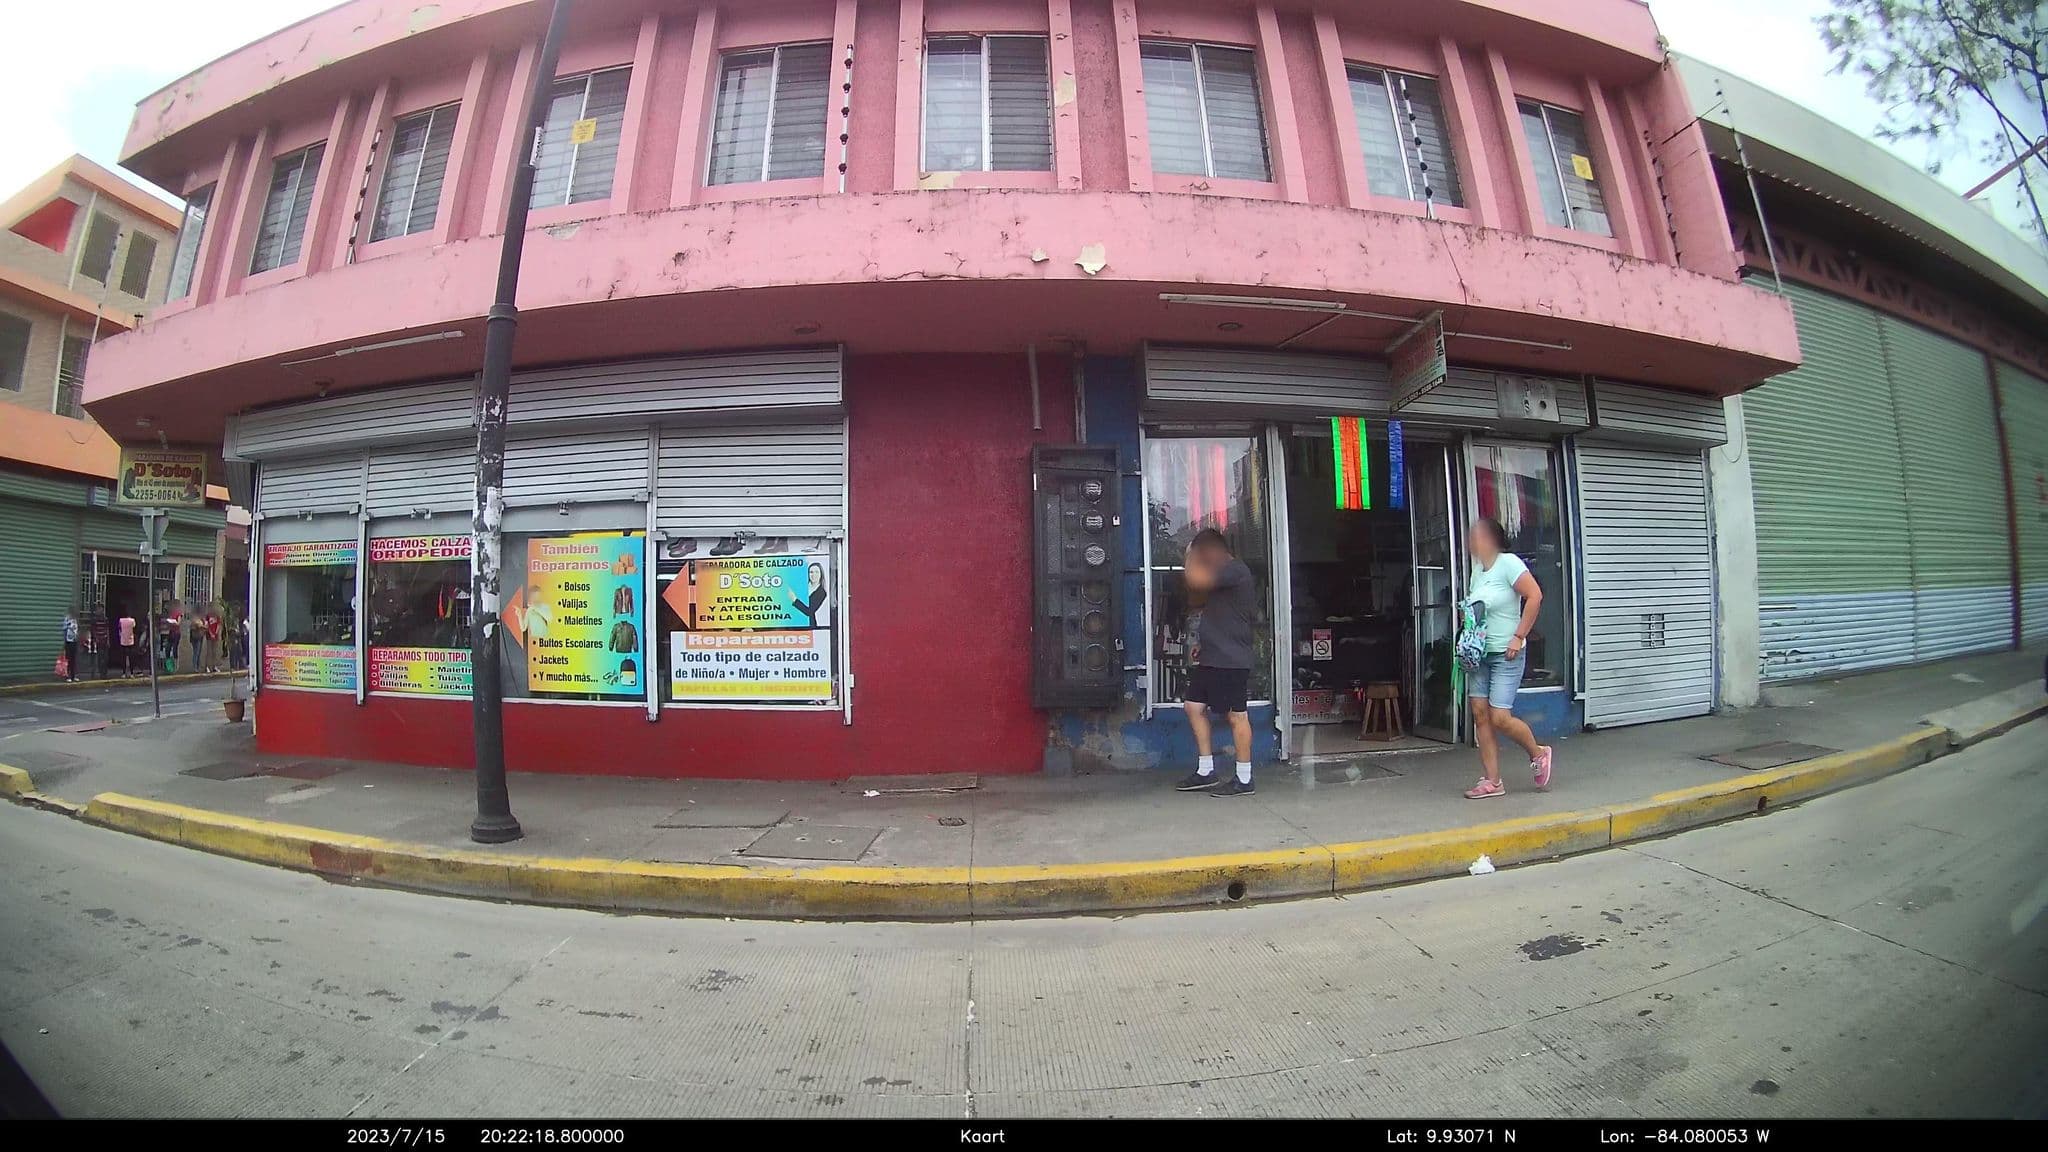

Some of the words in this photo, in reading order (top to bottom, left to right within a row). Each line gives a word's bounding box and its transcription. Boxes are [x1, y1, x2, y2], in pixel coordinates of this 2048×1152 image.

[268, 544, 301, 552] TRABAJO
[303, 542, 358, 551] GARANTIZADO
[371, 539, 427, 549] HACEMOS
[532, 560, 609, 572] Reparamos
[702, 560, 751, 569] EPARADORA
[753, 560, 764, 568] DE
[766, 559, 804, 568] CALZADO
[564, 581, 591, 591] Bolsos
[561, 598, 588, 610] Valijas
[717, 595, 773, 603] ENTRADA
[564, 616, 603, 625] Maletines
[738, 613, 792, 621] ESQUINA
[538, 639, 563, 648] Bultos
[565, 638, 604, 648] Escolares
[687, 634, 811, 647] Reparamos
[373, 650, 422, 662] REPARAMOS
[424, 651, 446, 662] TODO
[448, 652, 467, 662] TIPO
[538, 655, 569, 665] Jackets
[680, 652, 711, 662] Todo
[715, 651, 741, 664] tipo
[745, 651, 762, 662] de
[766, 651, 820, 662] calzado
[379, 663, 409, 671] Bolsos
[379, 672, 408, 681] Valijas
[539, 672, 544, 681] Y
[546, 671, 572, 682] mucho
[675, 668, 688, 678] de
[691, 667, 726, 678] Niño/a
[738, 668, 770, 680] Mujer
[783, 667, 827, 679] Hombre
[379, 680, 422, 688] Billeteras
